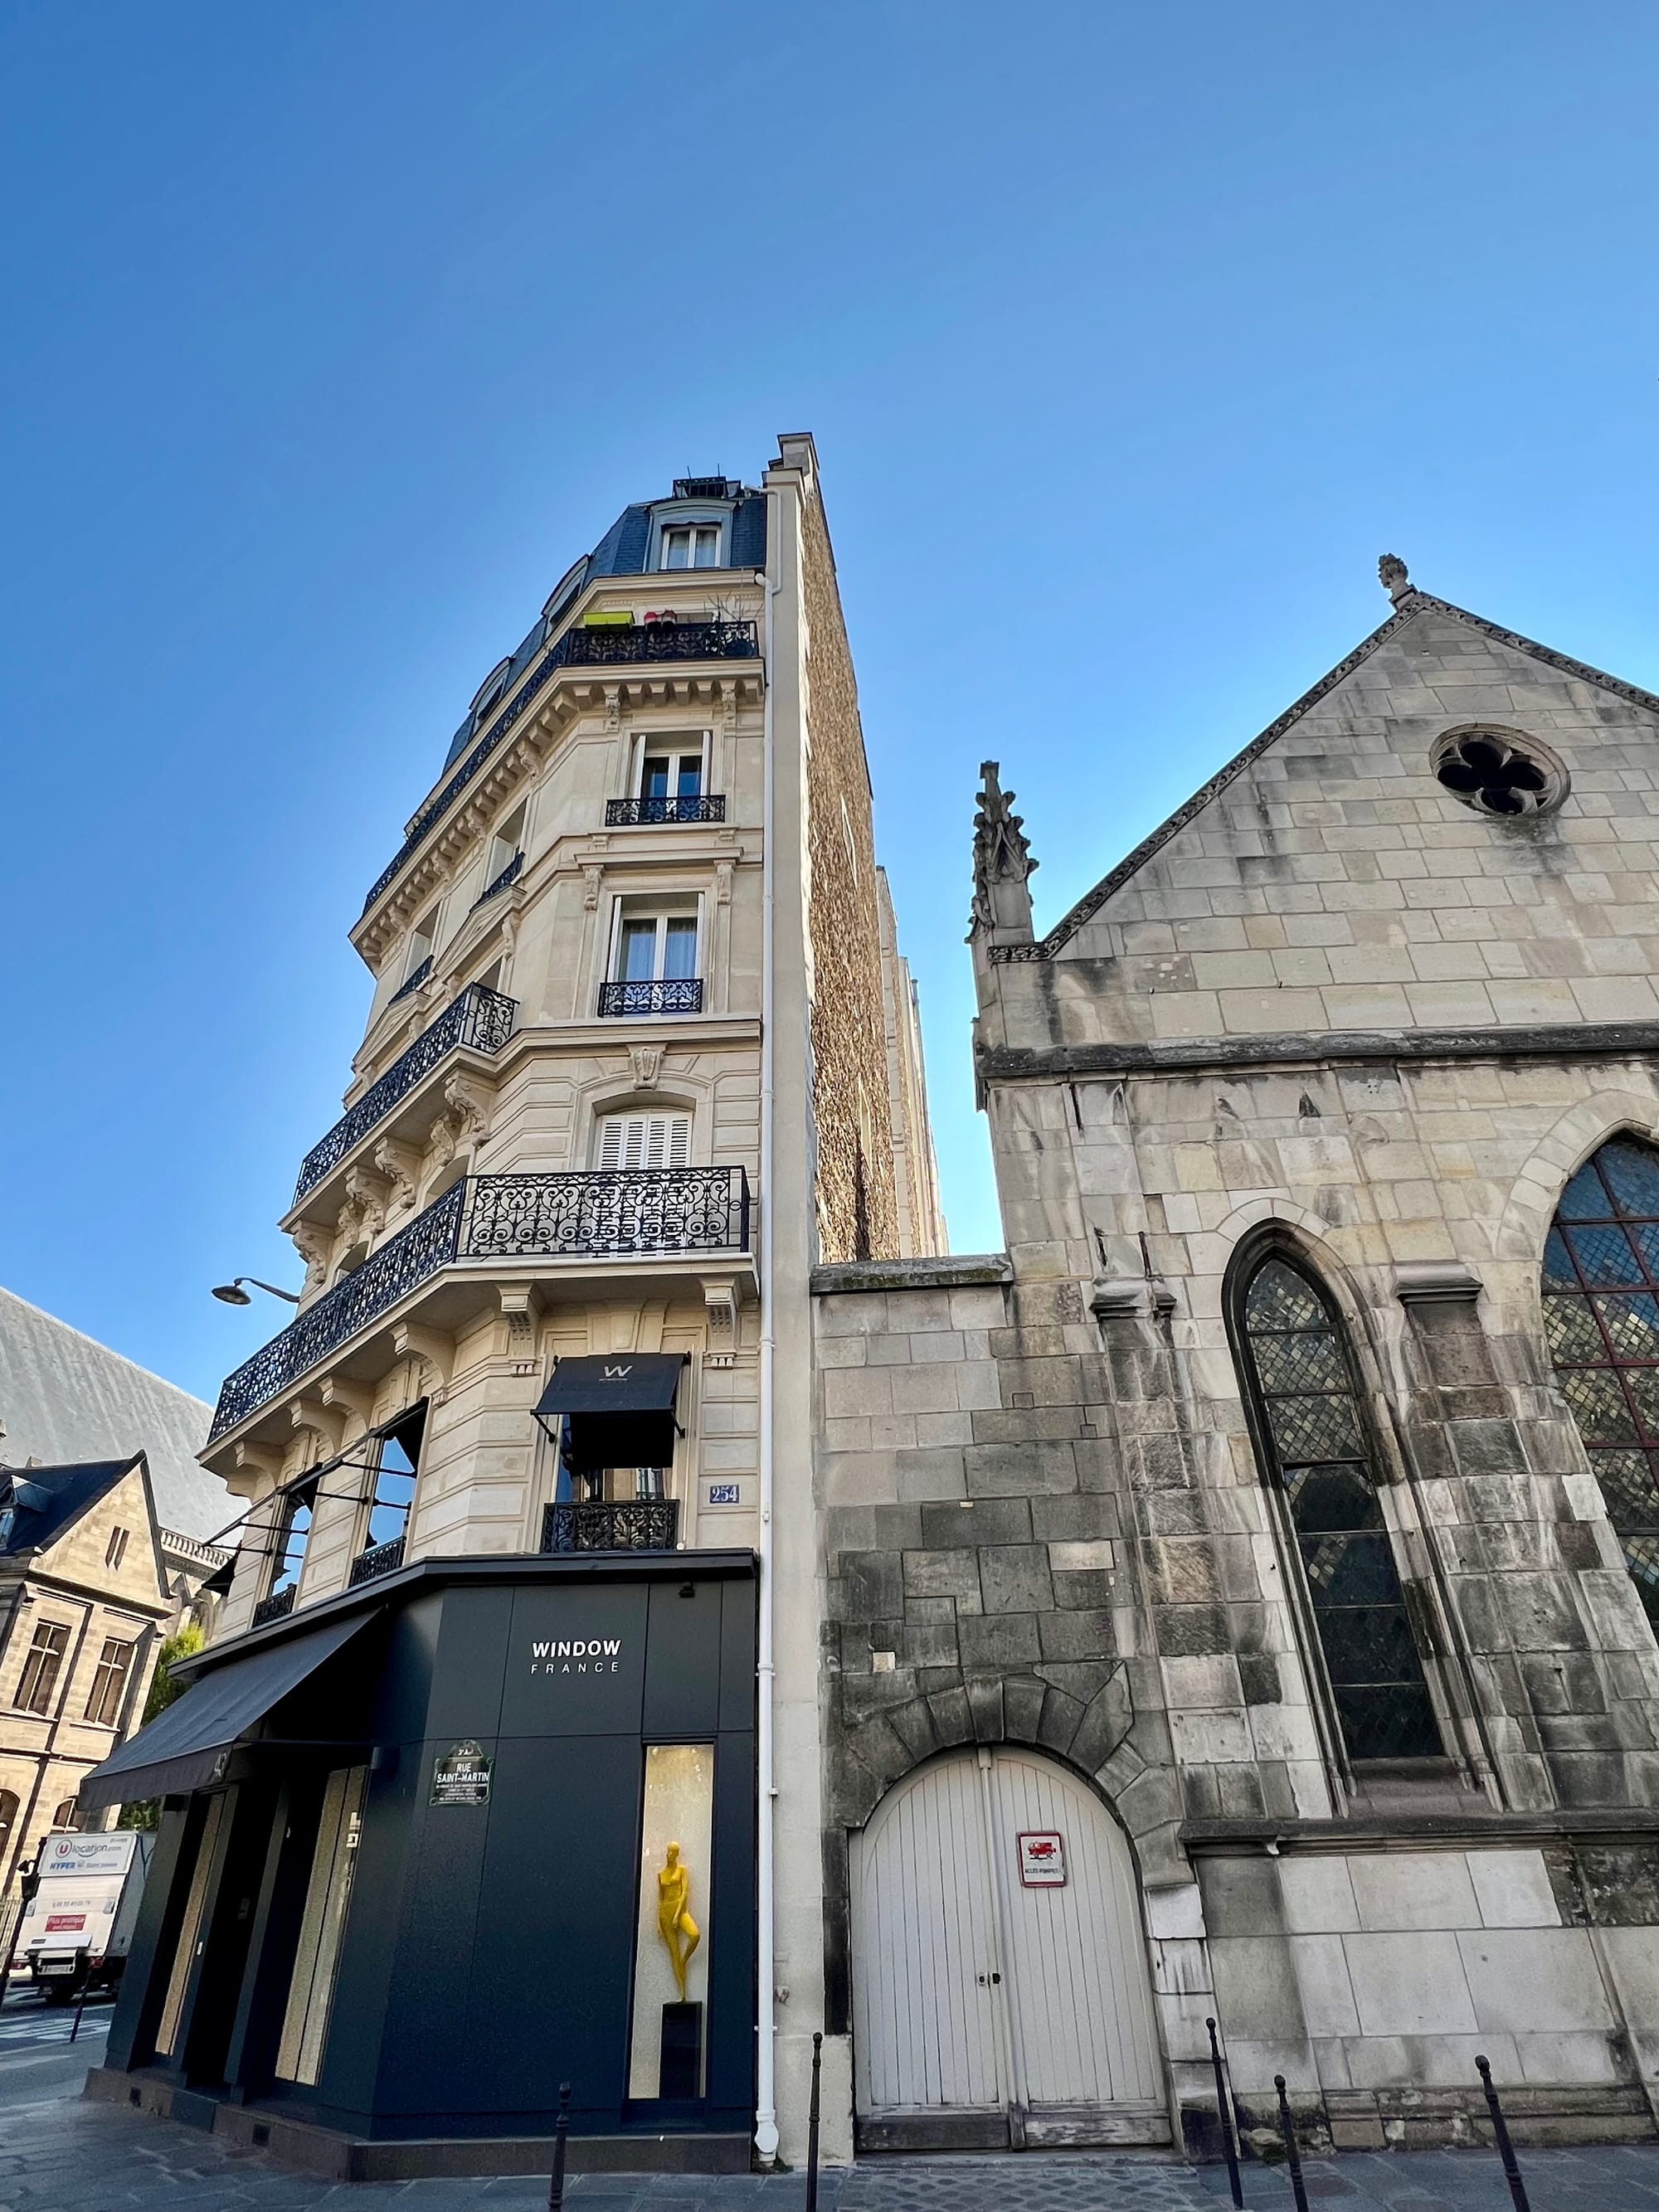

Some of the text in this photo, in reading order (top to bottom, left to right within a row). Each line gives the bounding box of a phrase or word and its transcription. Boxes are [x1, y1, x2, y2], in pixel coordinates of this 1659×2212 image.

[604, 1365, 633, 1377] W
[712, 1485, 737, 1502] 254
[533, 1640, 621, 1658] WINDOW
[531, 1661, 619, 1675] FRANCE
[456, 1763, 471, 1772] RUE
[437, 1772, 489, 1783] SAINT-MARTIN
[50, 1861, 76, 1870] HYPER
